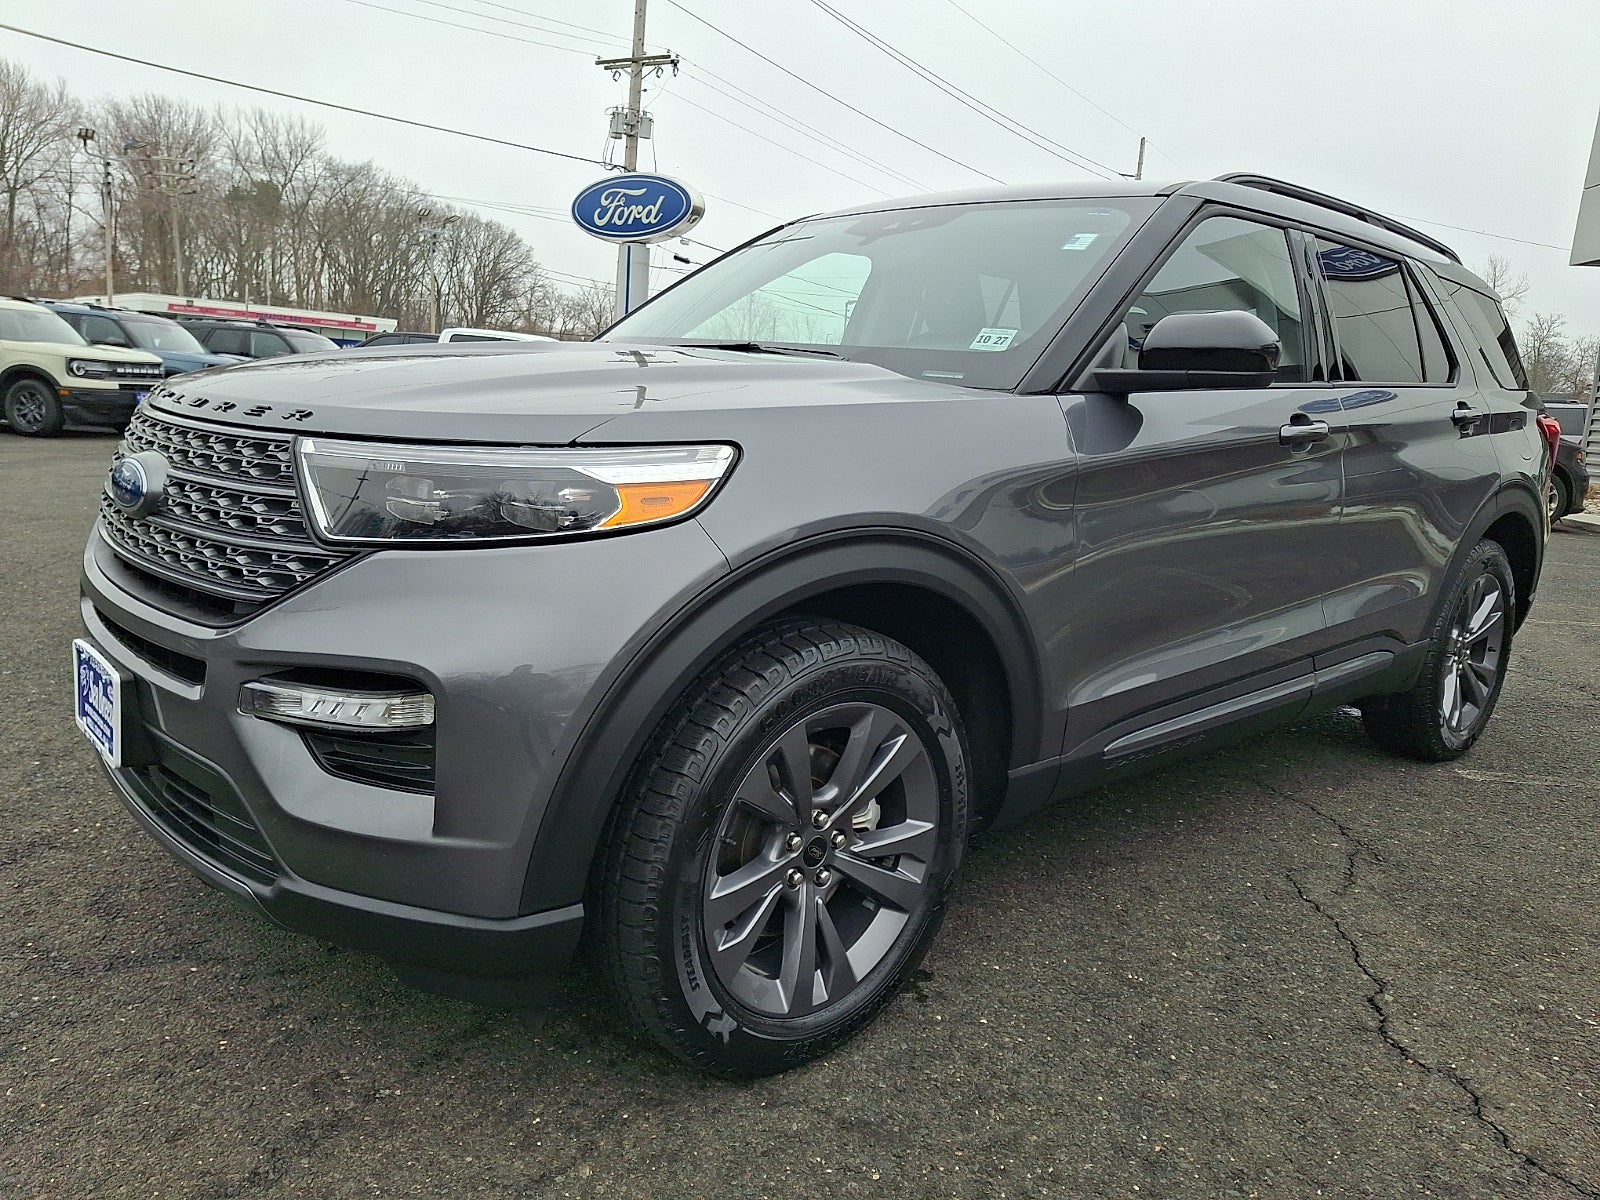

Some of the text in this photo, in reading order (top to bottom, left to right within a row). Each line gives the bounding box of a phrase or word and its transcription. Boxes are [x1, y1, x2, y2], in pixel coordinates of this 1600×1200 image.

[593, 187, 666, 227] Ford
[976, 334, 1010, 345] 10 27
